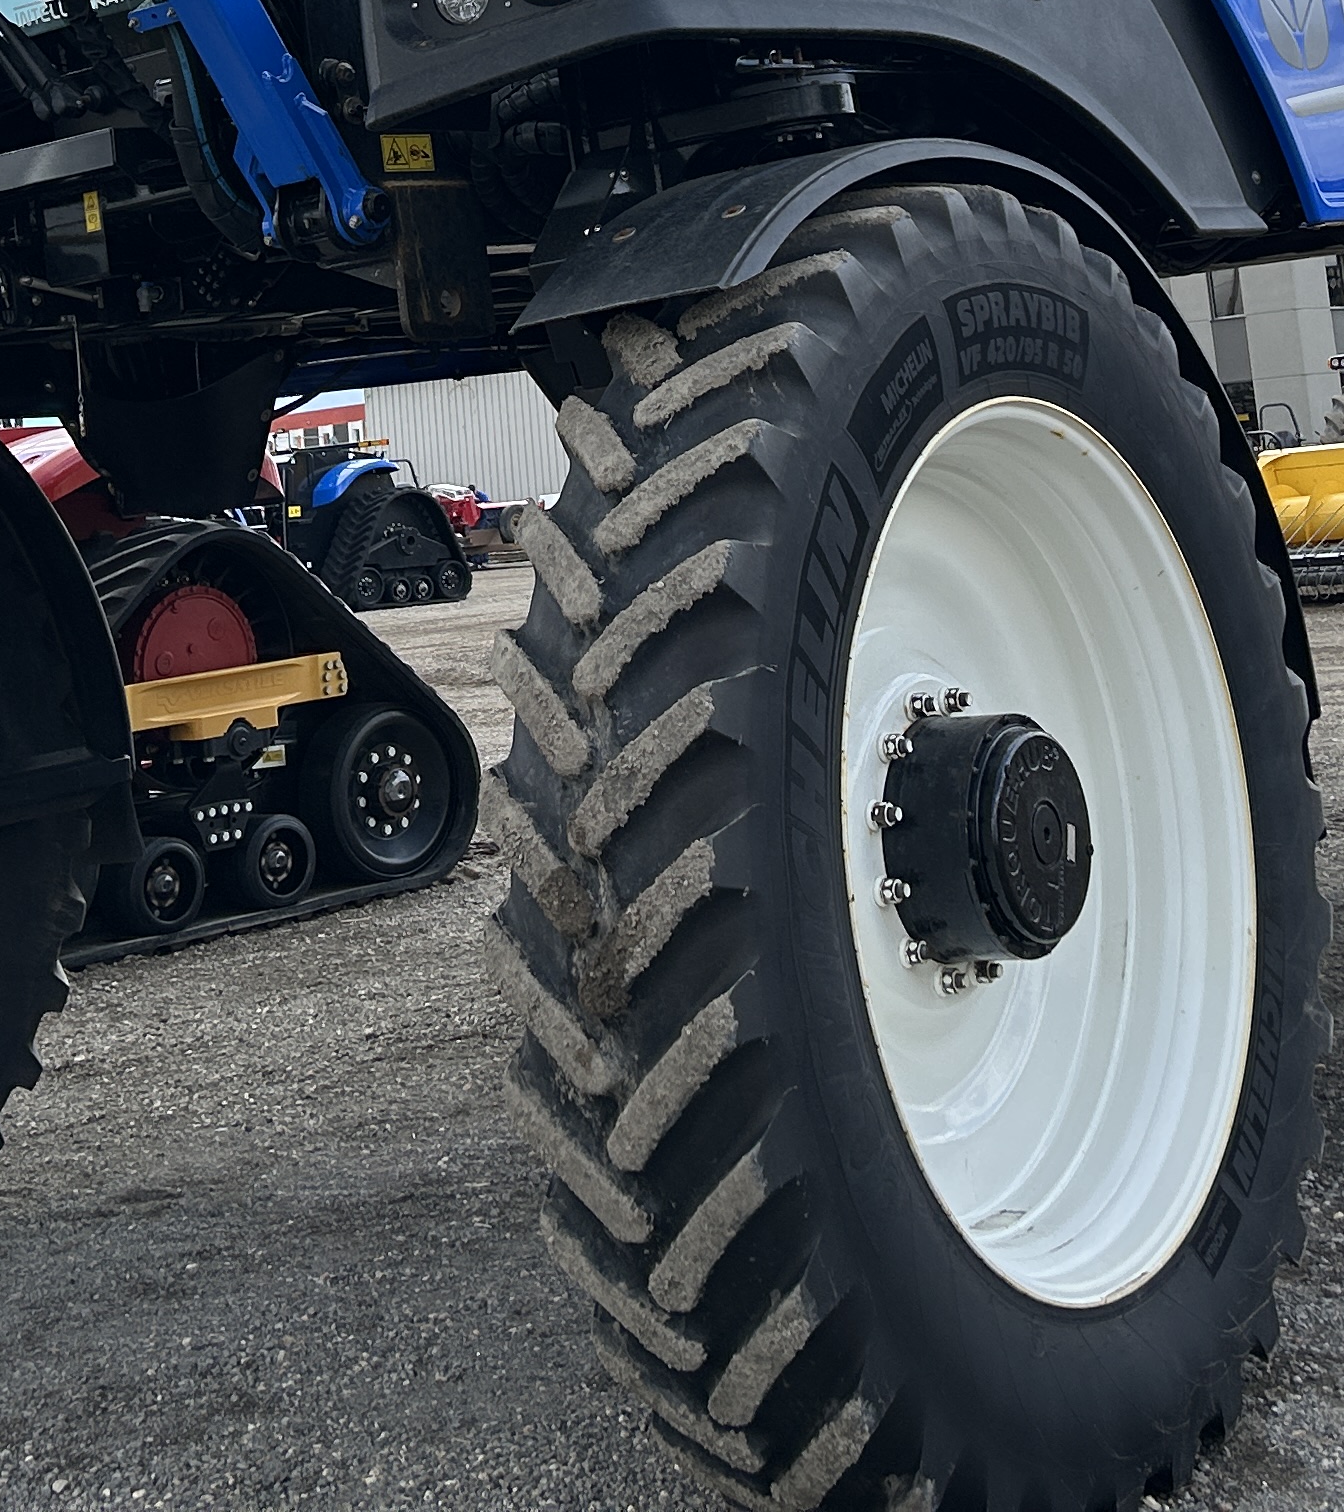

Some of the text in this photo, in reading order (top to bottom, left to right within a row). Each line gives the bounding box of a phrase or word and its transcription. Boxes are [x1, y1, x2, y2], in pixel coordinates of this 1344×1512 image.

[956, 289, 1081, 344] SPRAYBIB
[880, 337, 934, 416] MICHELIN
[959, 343, 982, 376] VF
[1062, 348, 1083, 380] 50
